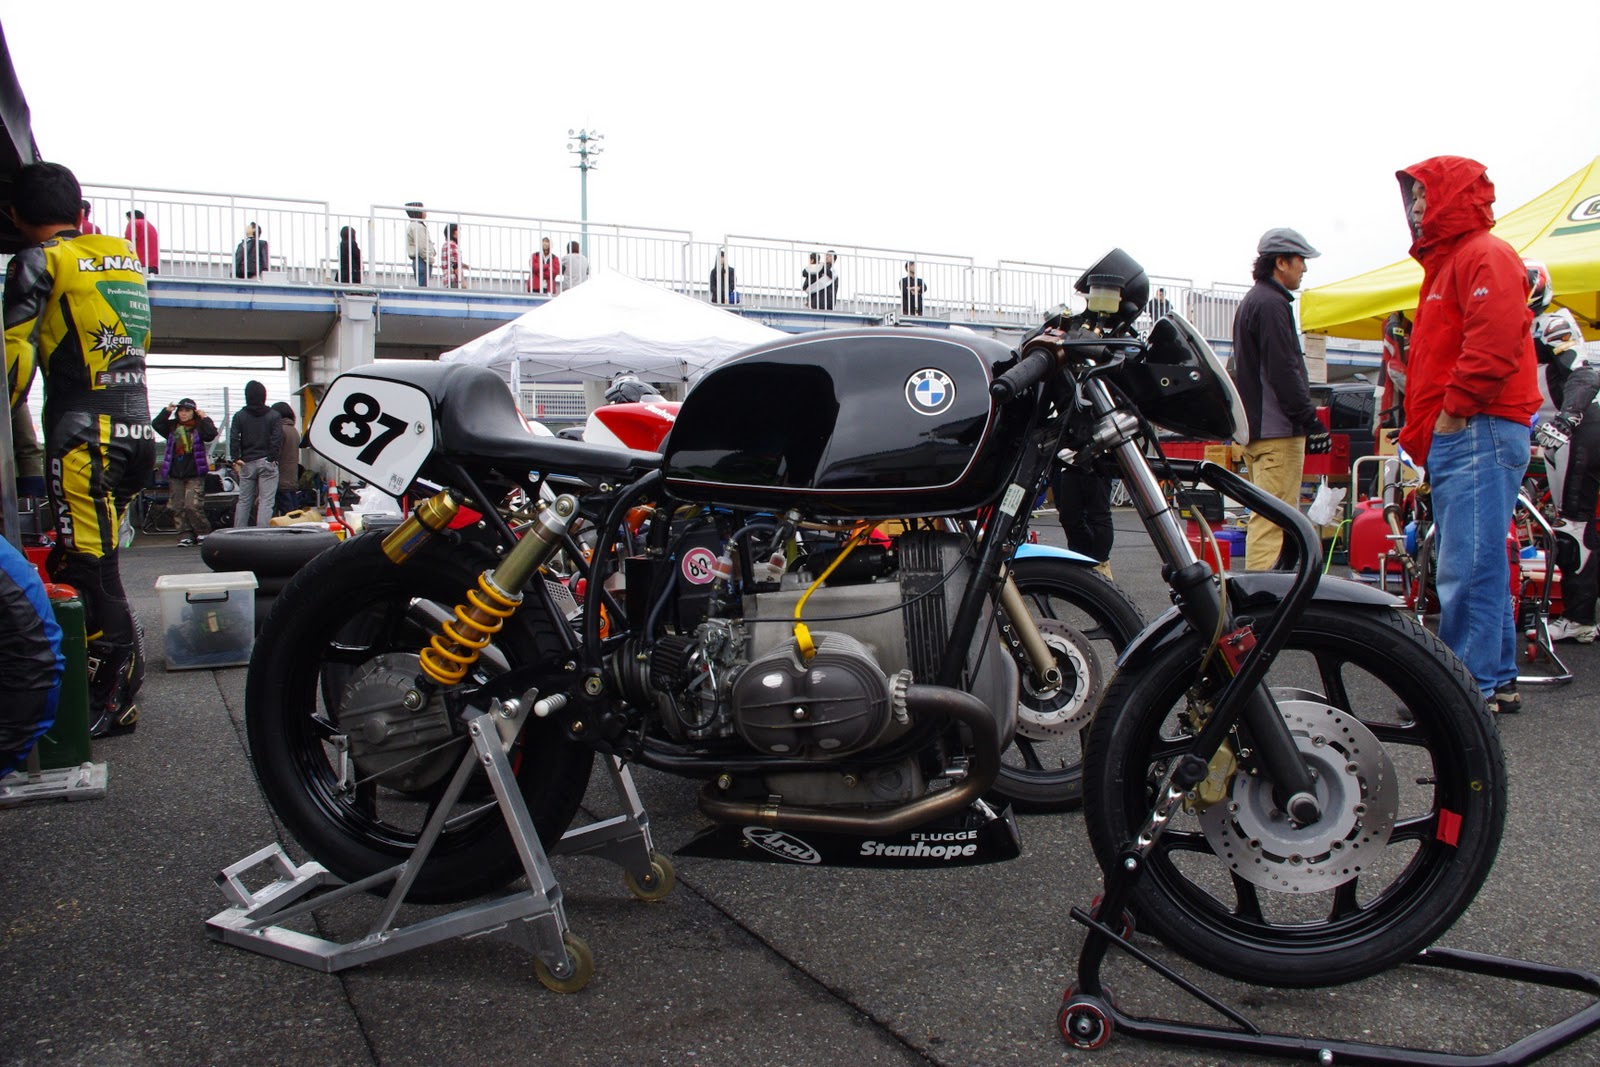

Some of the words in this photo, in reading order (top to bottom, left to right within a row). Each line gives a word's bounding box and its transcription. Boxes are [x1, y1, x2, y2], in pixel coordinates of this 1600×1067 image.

[107, 334, 132, 345] Team
[910, 371, 951, 386] BMW
[329, 392, 409, 467] 87
[910, 830, 978, 841] FLUGGE
[860, 840, 978, 860] Stanhope
